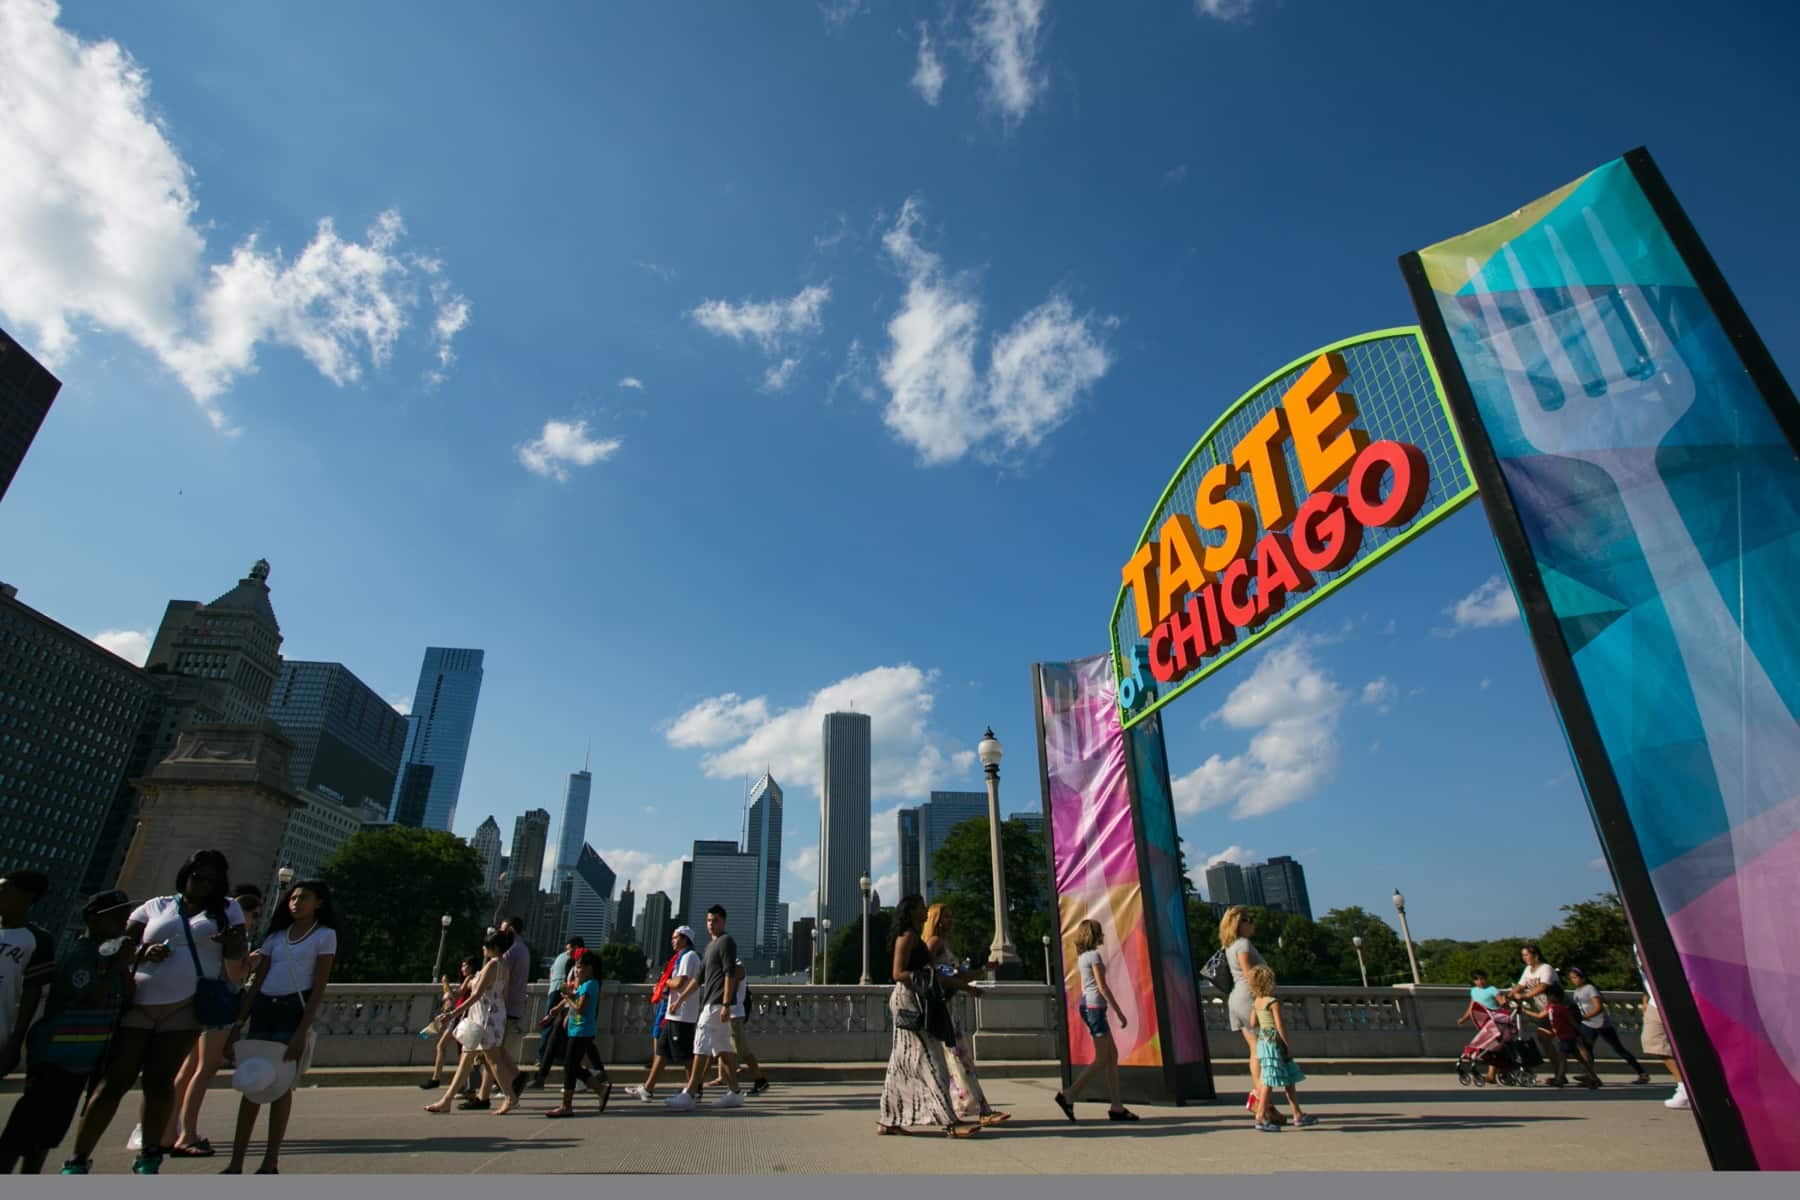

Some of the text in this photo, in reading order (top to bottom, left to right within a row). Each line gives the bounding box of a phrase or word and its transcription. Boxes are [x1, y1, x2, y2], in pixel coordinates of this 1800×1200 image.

[1119, 439, 1421, 708] of CHICAGO
[1122, 352, 1362, 638] TASTE
